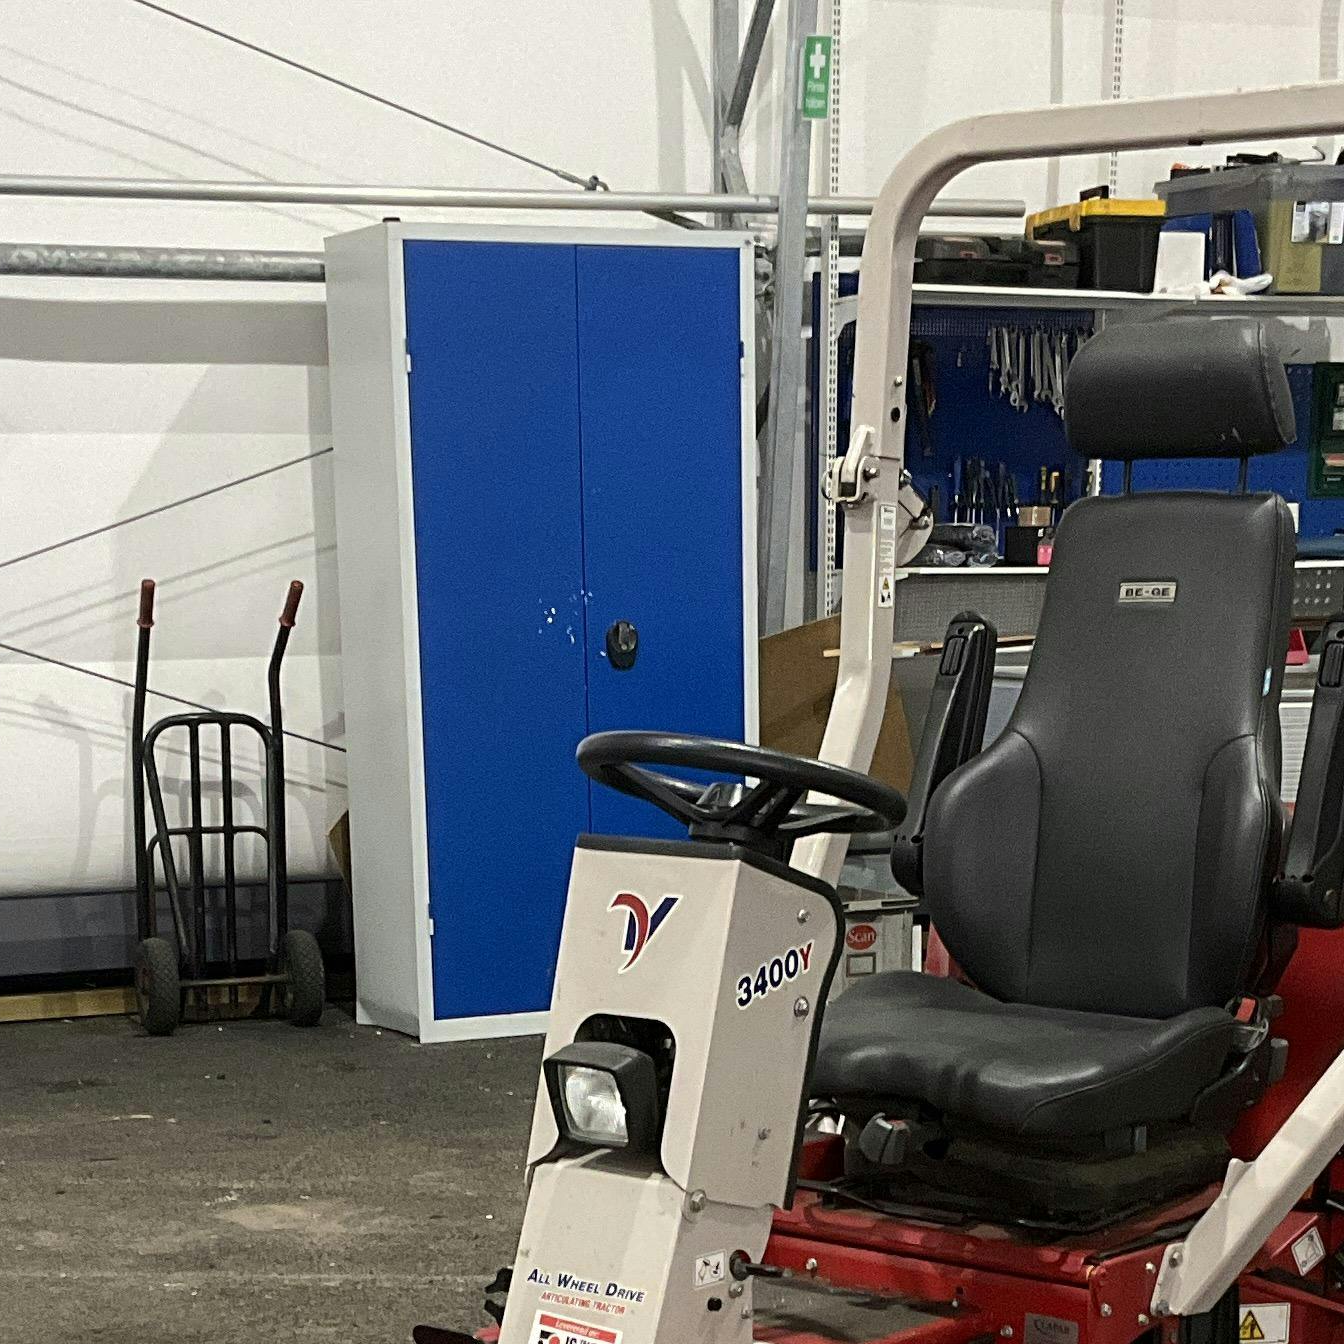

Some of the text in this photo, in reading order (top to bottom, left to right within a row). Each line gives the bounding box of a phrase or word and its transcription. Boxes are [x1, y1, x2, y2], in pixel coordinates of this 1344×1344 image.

[1125, 587, 1170, 597] BE-GE
[848, 929, 875, 943] Scan
[737, 941, 813, 1008] 3400Y
[527, 1268, 646, 1303] ALL WHEEL DRIVE
[541, 1292, 625, 1315] ARTICULATING TRACTOR
